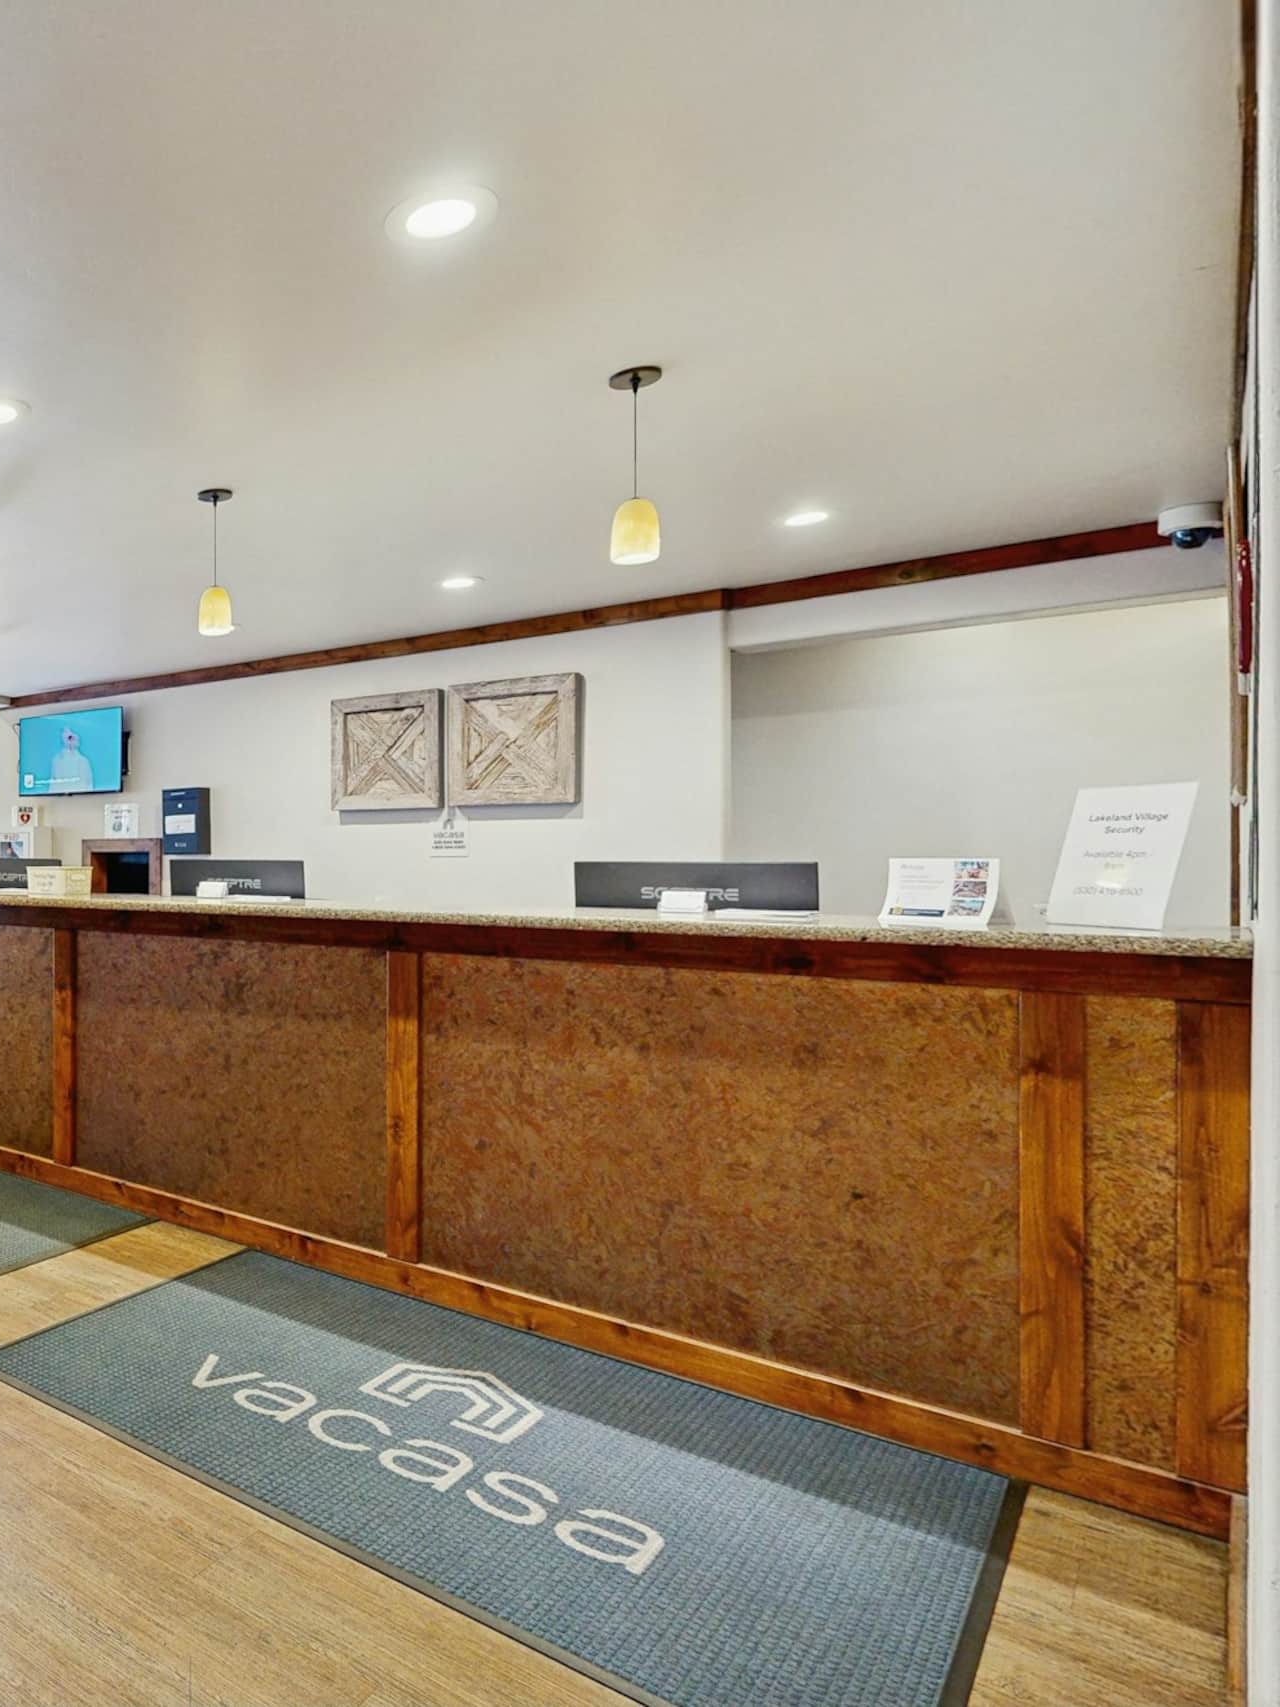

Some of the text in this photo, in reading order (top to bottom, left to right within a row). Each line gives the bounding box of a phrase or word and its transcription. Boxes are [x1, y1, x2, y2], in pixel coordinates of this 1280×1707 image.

[1088, 812, 1169, 822] Lakeland Village
[1104, 826, 1144, 835] Security
[191, 1353, 665, 1576] vacasa
